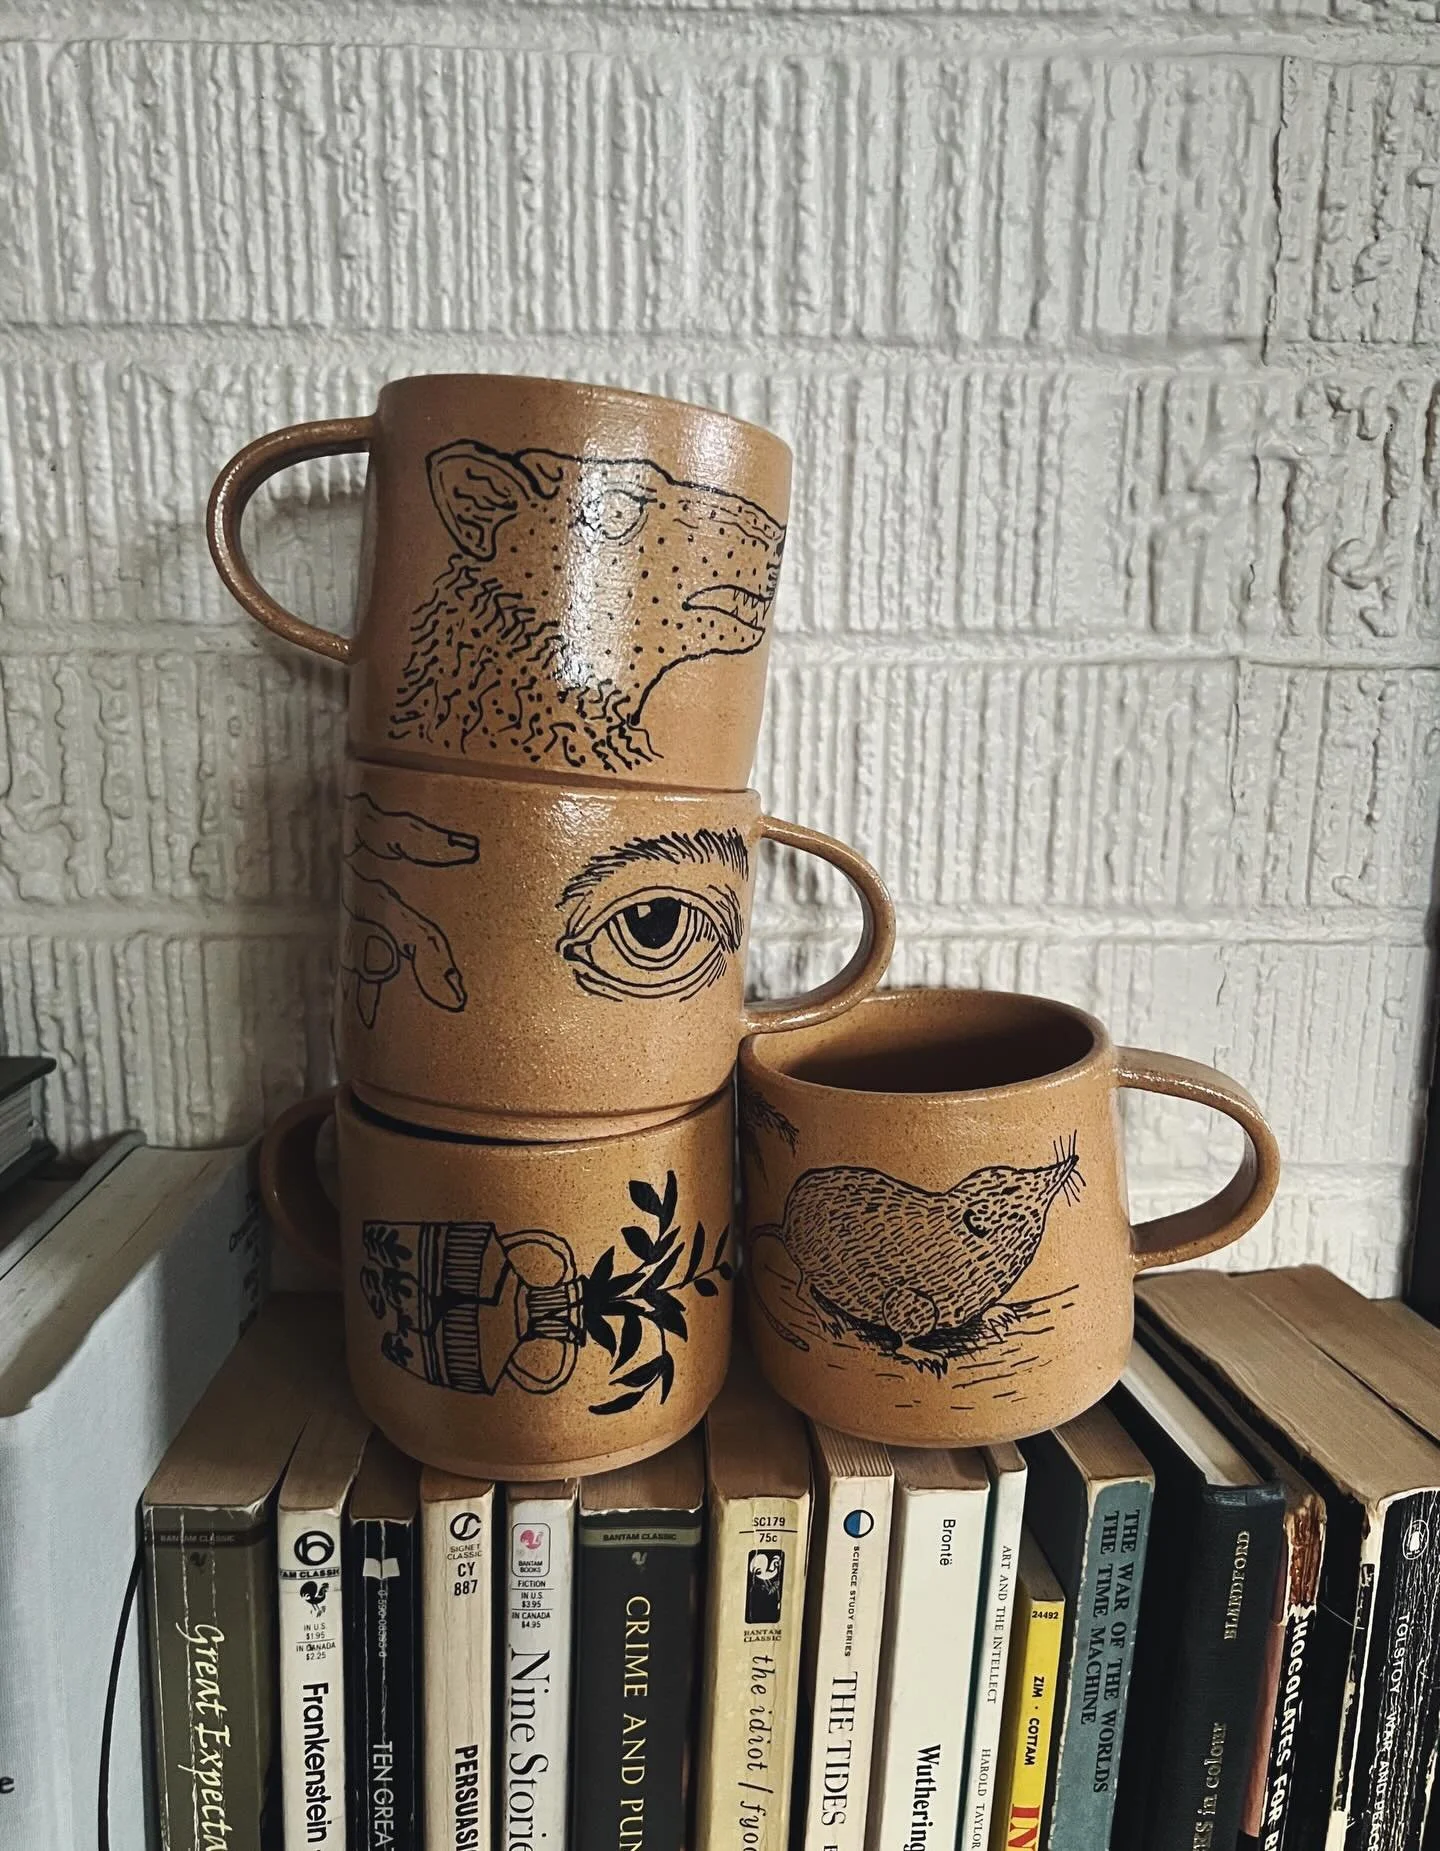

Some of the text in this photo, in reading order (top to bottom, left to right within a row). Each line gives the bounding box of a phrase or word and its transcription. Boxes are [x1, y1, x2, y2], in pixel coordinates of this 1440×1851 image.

[450, 1543, 480, 1553] SIGNET
[753, 1516, 786, 1527] SC179
[939, 1519, 956, 1566] Brontë
[447, 1551, 482, 1561] CLASSIC
[454, 1579, 478, 1596] 887
[457, 1562, 475, 1577] CY
[303, 1623, 311, 1631] IN
[521, 1611, 551, 1619] CANADA
[521, 1621, 541, 1629] $4.95
[744, 1629, 782, 1637] BANTAM
[844, 1545, 860, 1657] SCIENCE STUDY SERIES
[987, 1545, 1012, 1704] ART AND THE INTELLECT
[1031, 1611, 1059, 1619] 24492
[1081, 1510, 1119, 1725] THE TIME MACHINE
[175, 1622, 228, 1716] Great
[296, 1642, 336, 1652] IN CANADA
[624, 1596, 651, 1698] CRIME
[750, 1655, 776, 1695] the
[1093, 1509, 1141, 1793] THE WAR OF THE WORLDS
[1390, 1611, 1411, 1693] TOLSTOY
[510, 1649, 550, 1743] Nine
[829, 1671, 858, 1734] THE
[1024, 1676, 1045, 1766] ZIM COTTAM
[303, 1682, 332, 1843] Frankenstein
[621, 1713, 647, 1785] AND
[747, 1705, 773, 1771] idiot
[1204, 1722, 1227, 1789] colour
[373, 1741, 395, 1851] TEN GREA
[821, 1740, 852, 1826] TIDES
[971, 1748, 991, 1849] HAROLD TAYLOR
[1197, 1794, 1217, 1815] in
[1268, 1773, 1288, 1826] FOR
